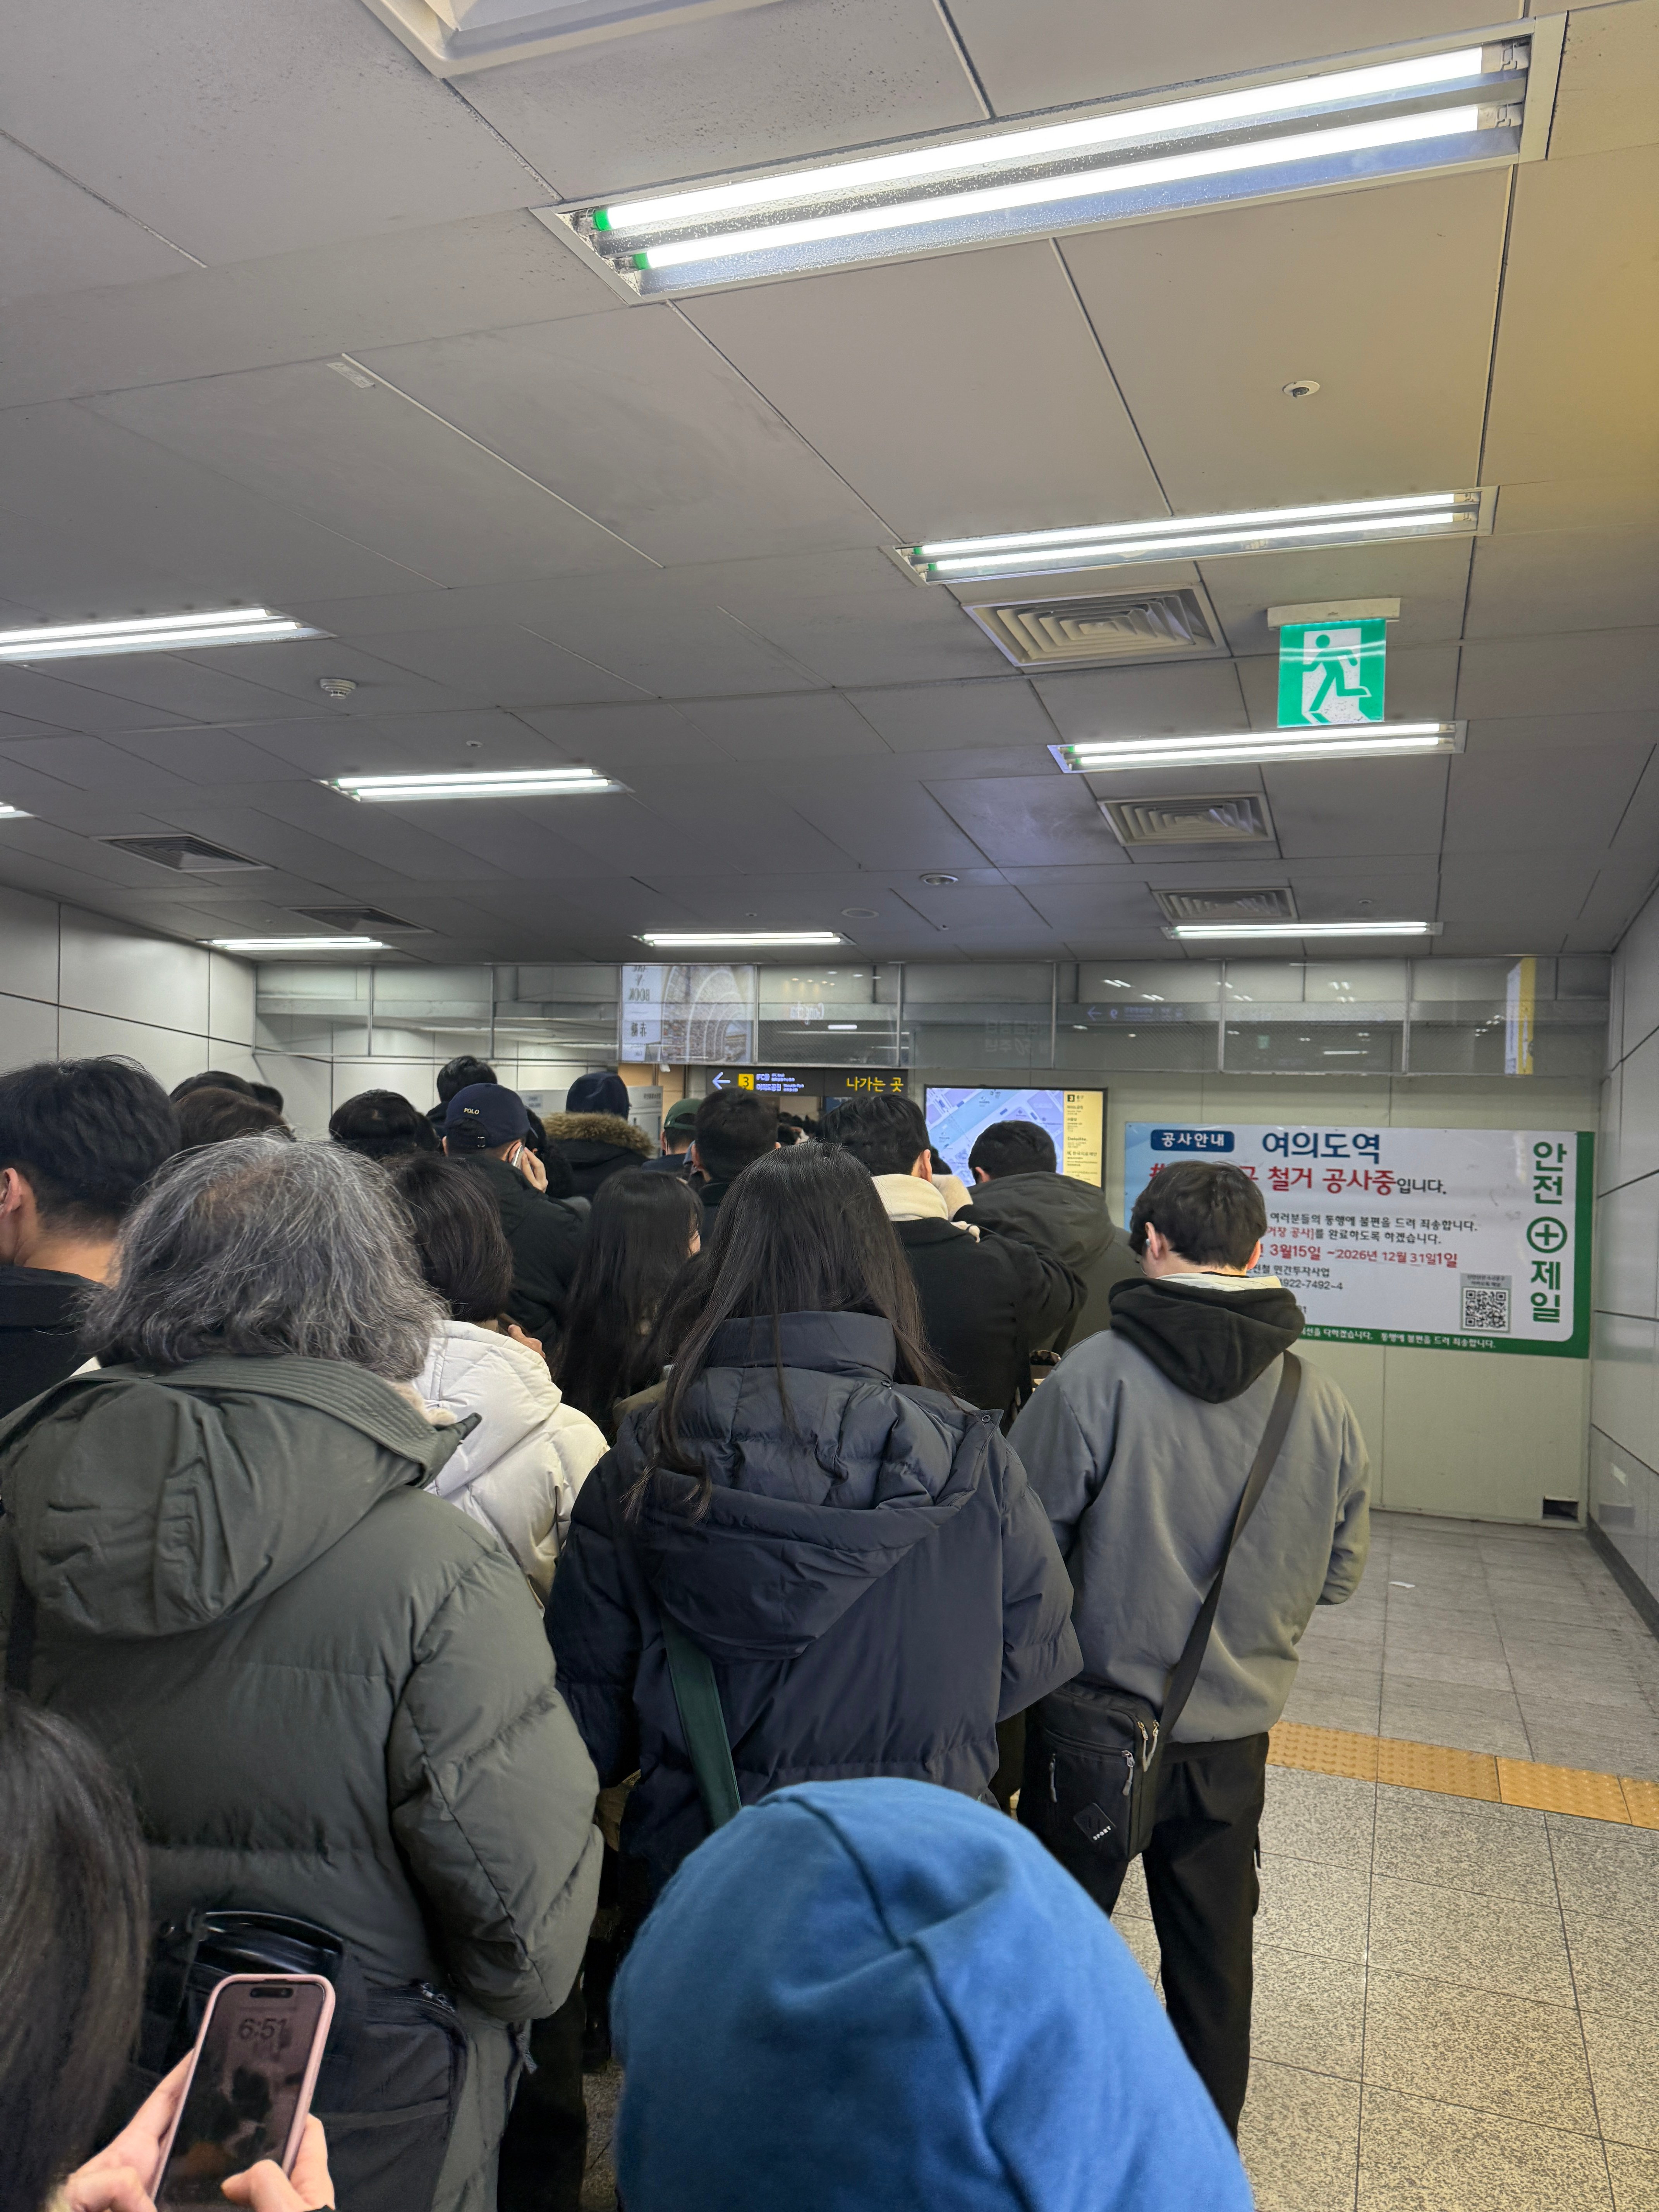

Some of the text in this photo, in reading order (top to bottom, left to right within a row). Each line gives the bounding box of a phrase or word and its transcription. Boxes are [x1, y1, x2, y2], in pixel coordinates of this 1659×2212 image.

[743, 1076, 749, 1087] 3
[847, 1076, 904, 1092] 나가는 곳
[1162, 1132, 1224, 1148] 공사안내
[1262, 1132, 1379, 1164] 여의도역
[1267, 1166, 1312, 1192] 철거
[1322, 1168, 1447, 1196] 공사중입니다.
[1533, 1141, 1567, 1205] 안전
[1270, 1212, 1478, 1231] 여러분들의 통행에 불편을 드려 죄송합니다.
[1267, 1226, 1287, 1238] 거장
[1329, 1229, 1380, 1242] 완료하도록
[1384, 1231, 1441, 1245] 하겠습니다.
[1270, 1243, 1321, 1261] 3월15일
[1382, 1251, 1407, 1264] 12월
[1530, 1260, 1561, 1323] 제일
